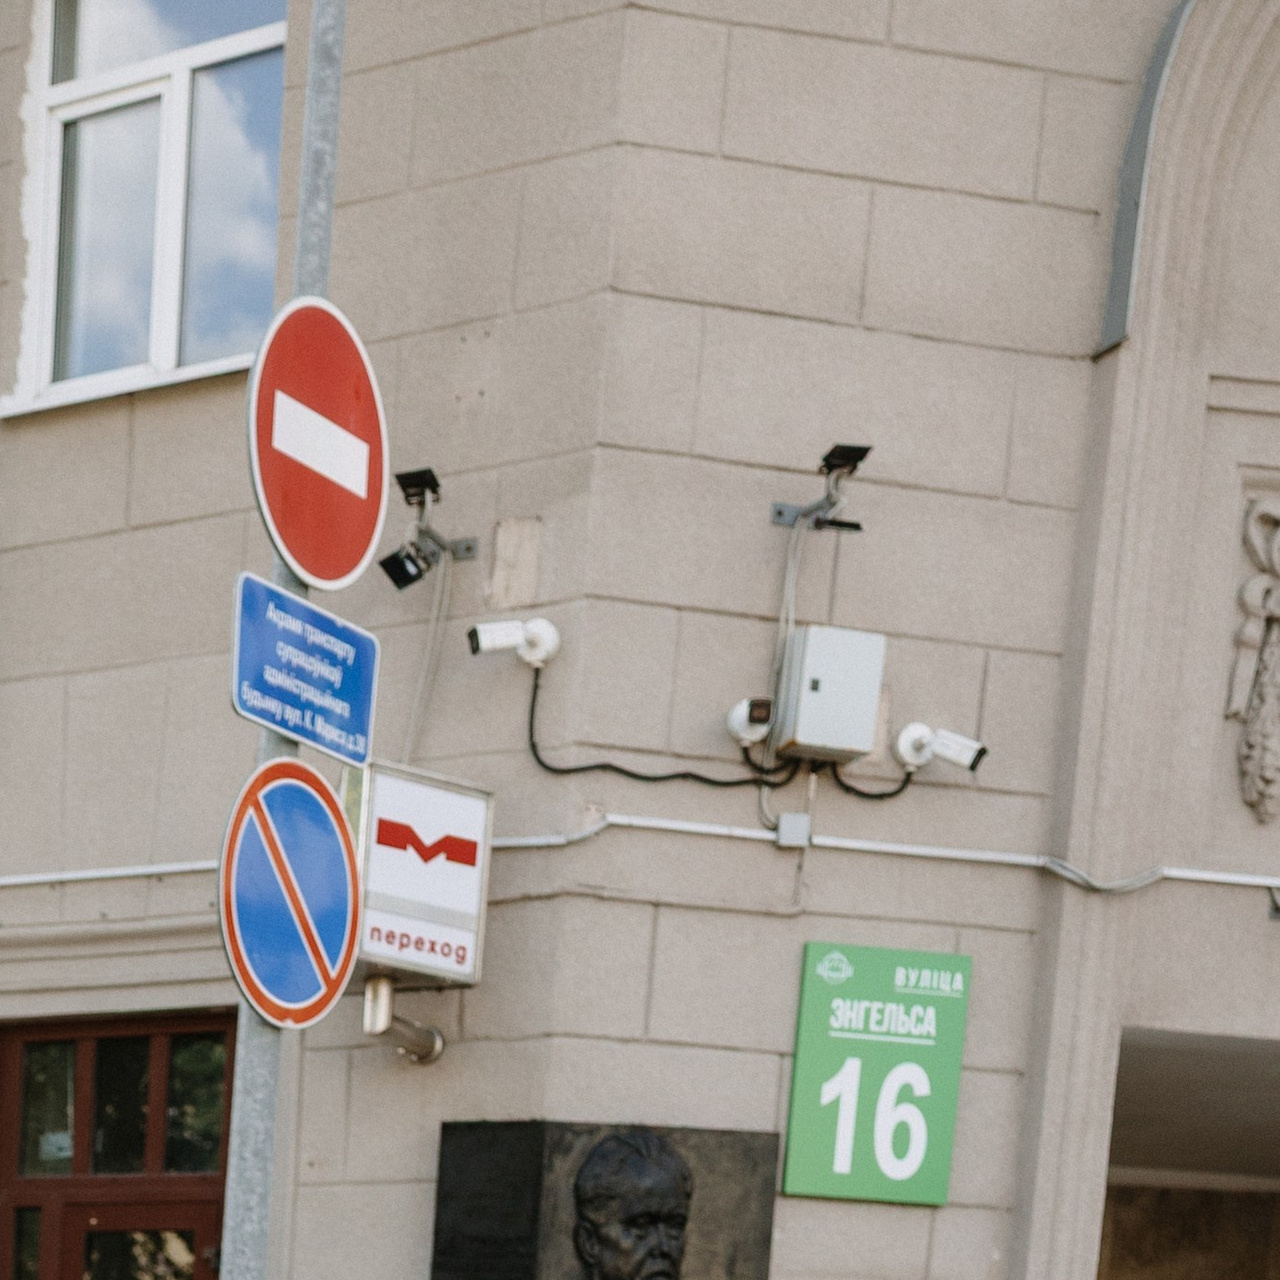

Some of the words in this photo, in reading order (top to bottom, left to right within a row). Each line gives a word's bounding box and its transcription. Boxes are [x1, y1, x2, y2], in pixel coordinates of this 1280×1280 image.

[895, 966, 964, 991] ВУЛІЦА
[829, 998, 937, 1037] ЭНГЕЛЬСА
[820, 1057, 932, 1181] 16
